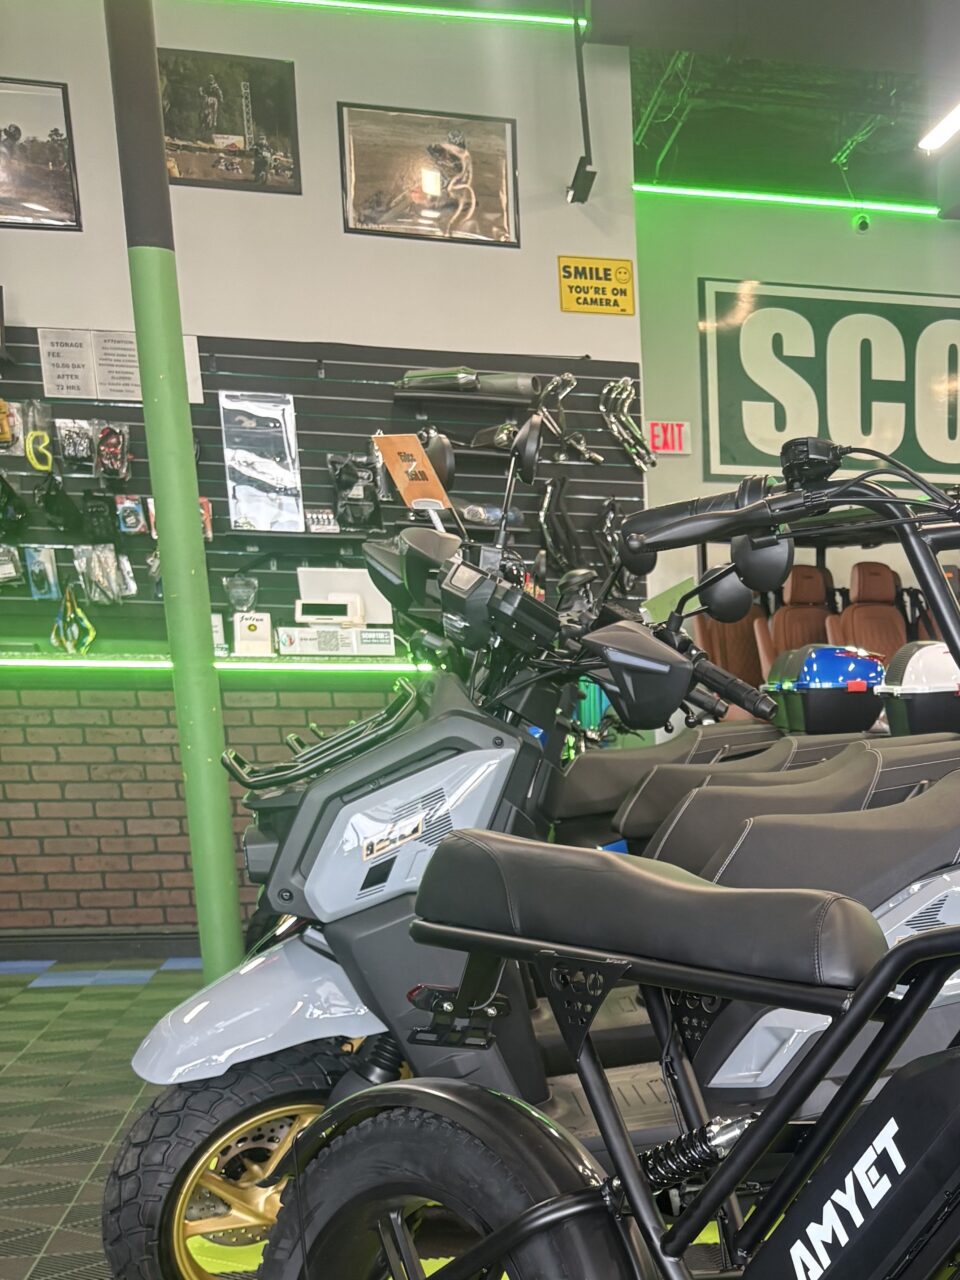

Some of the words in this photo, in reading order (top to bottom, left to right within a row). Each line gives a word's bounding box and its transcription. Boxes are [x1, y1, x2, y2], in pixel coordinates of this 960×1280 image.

[562, 265, 612, 281] SMILE
[567, 285, 607, 295] YOU'RE
[611, 287, 627, 296] ON
[576, 297, 620, 307] CAMERA
[650, 422, 684, 452] EXIT
